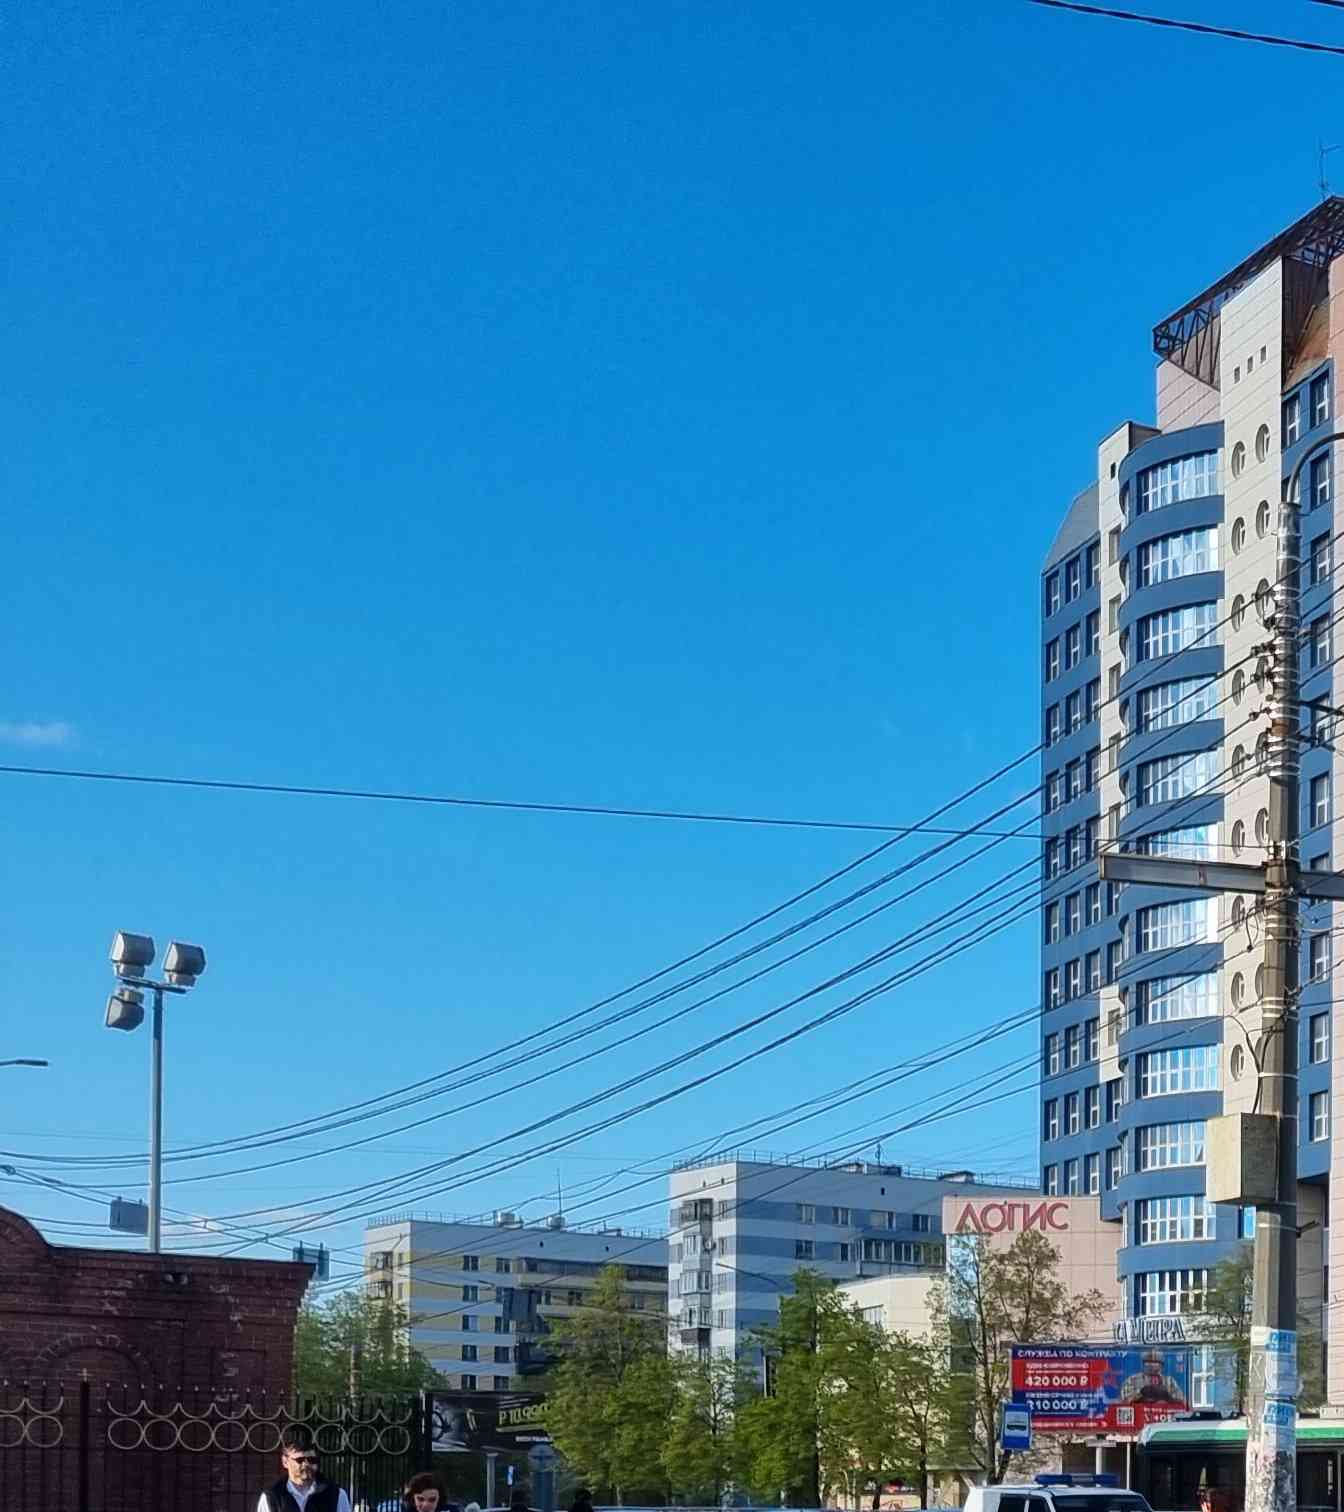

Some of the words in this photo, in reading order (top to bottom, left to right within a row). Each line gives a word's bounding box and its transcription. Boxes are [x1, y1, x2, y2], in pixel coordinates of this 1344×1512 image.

[955, 1201, 1069, 1232] ЛОГИС
[1025, 1376, 1049, 1386] 420
[1052, 1376, 1077, 1386] 000
